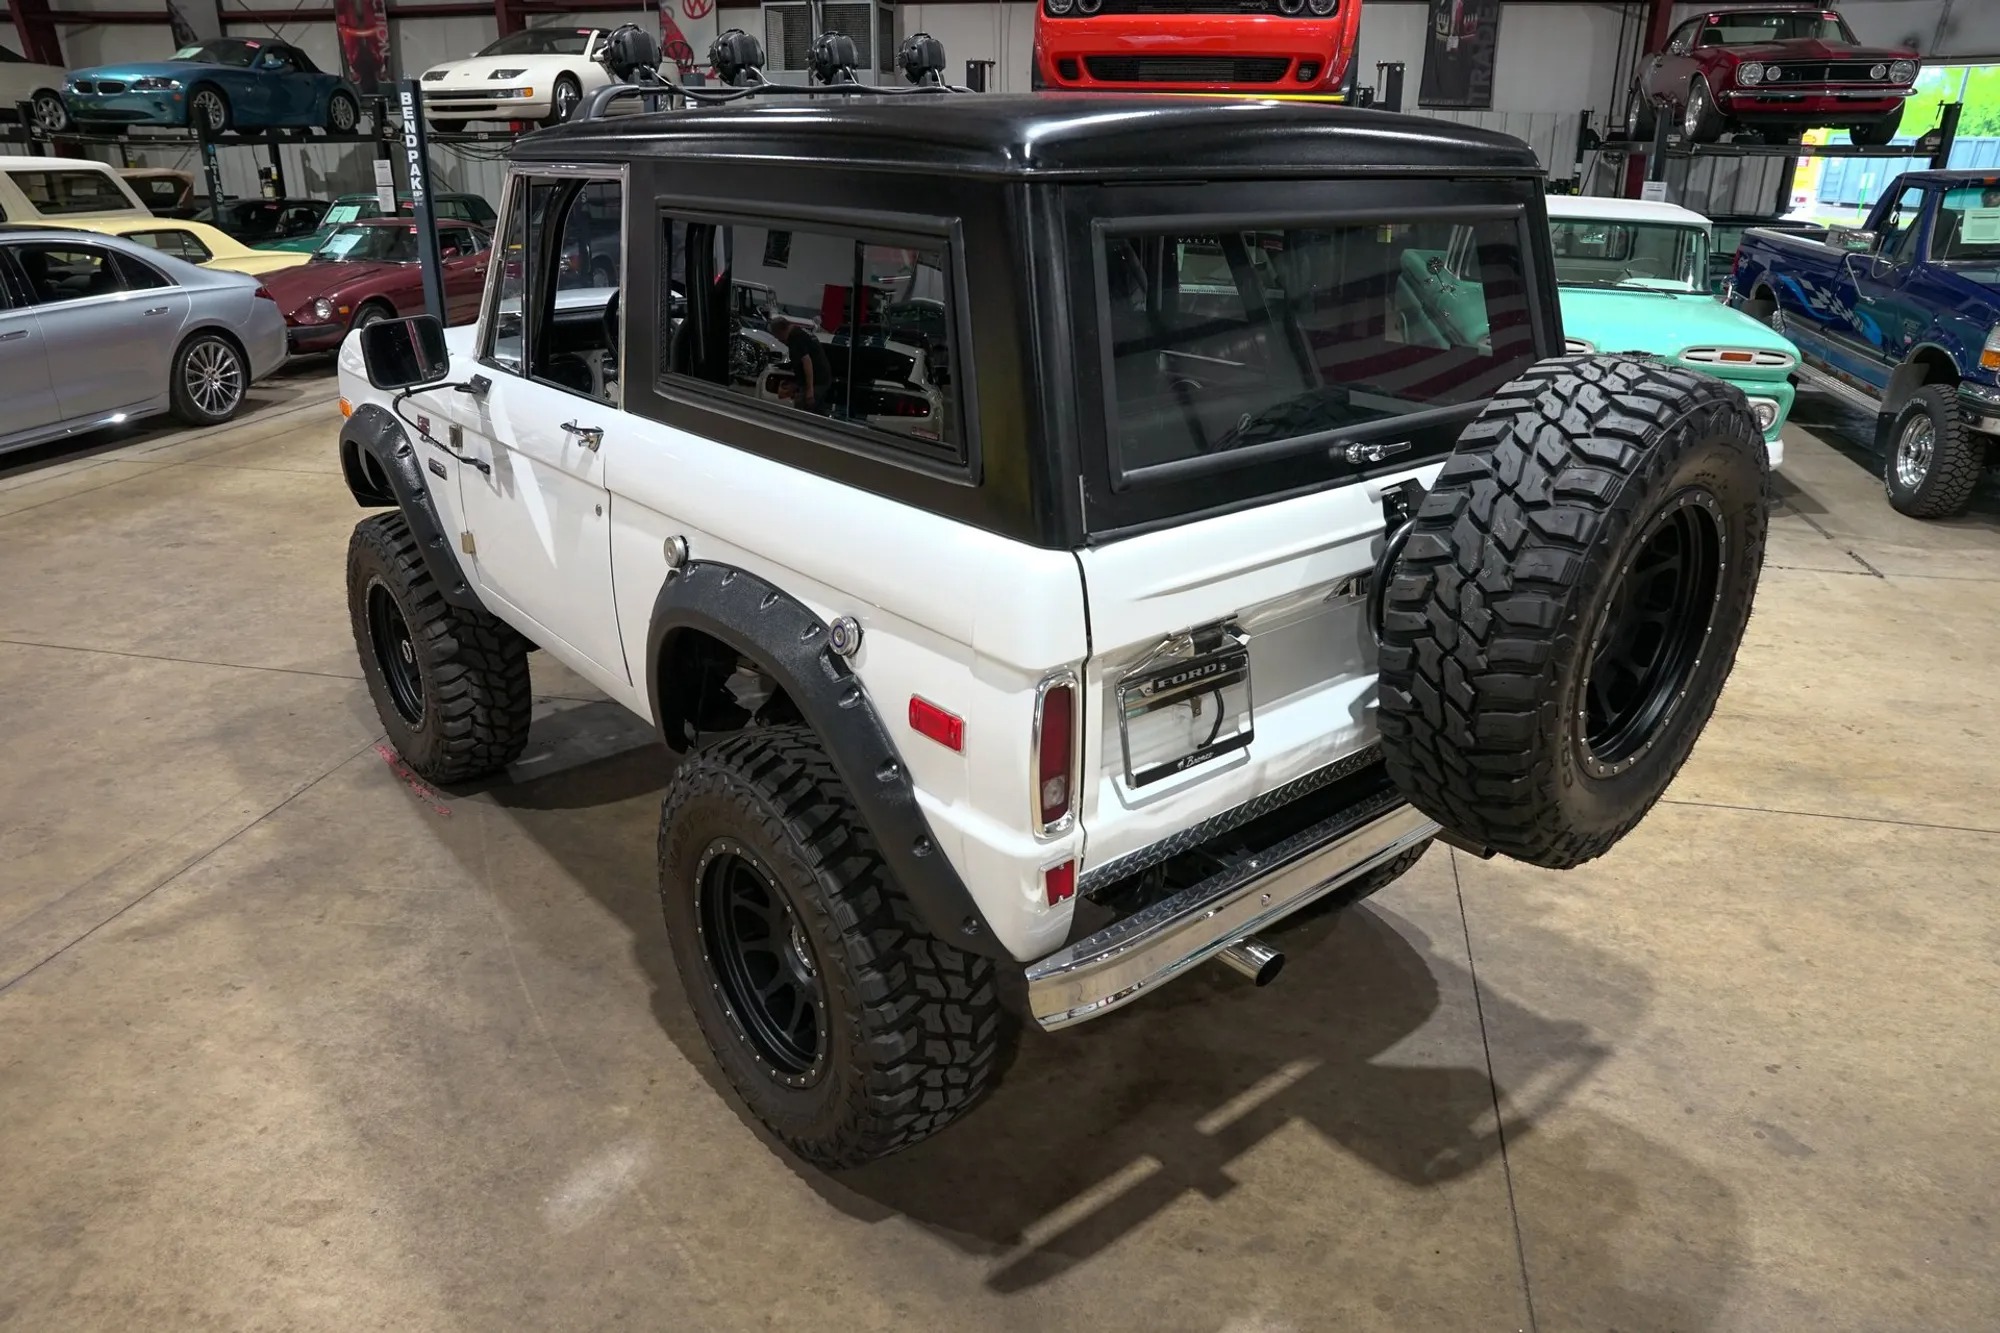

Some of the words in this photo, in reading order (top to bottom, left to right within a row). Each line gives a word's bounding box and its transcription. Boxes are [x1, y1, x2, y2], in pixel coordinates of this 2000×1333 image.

[400, 91, 423, 190] BENDPAK
[209, 155, 224, 203] ATLAS
[1178, 237, 1221, 245] VALIA
[1157, 663, 1217, 689] FORD
[1186, 752, 1214, 768] Bronco
